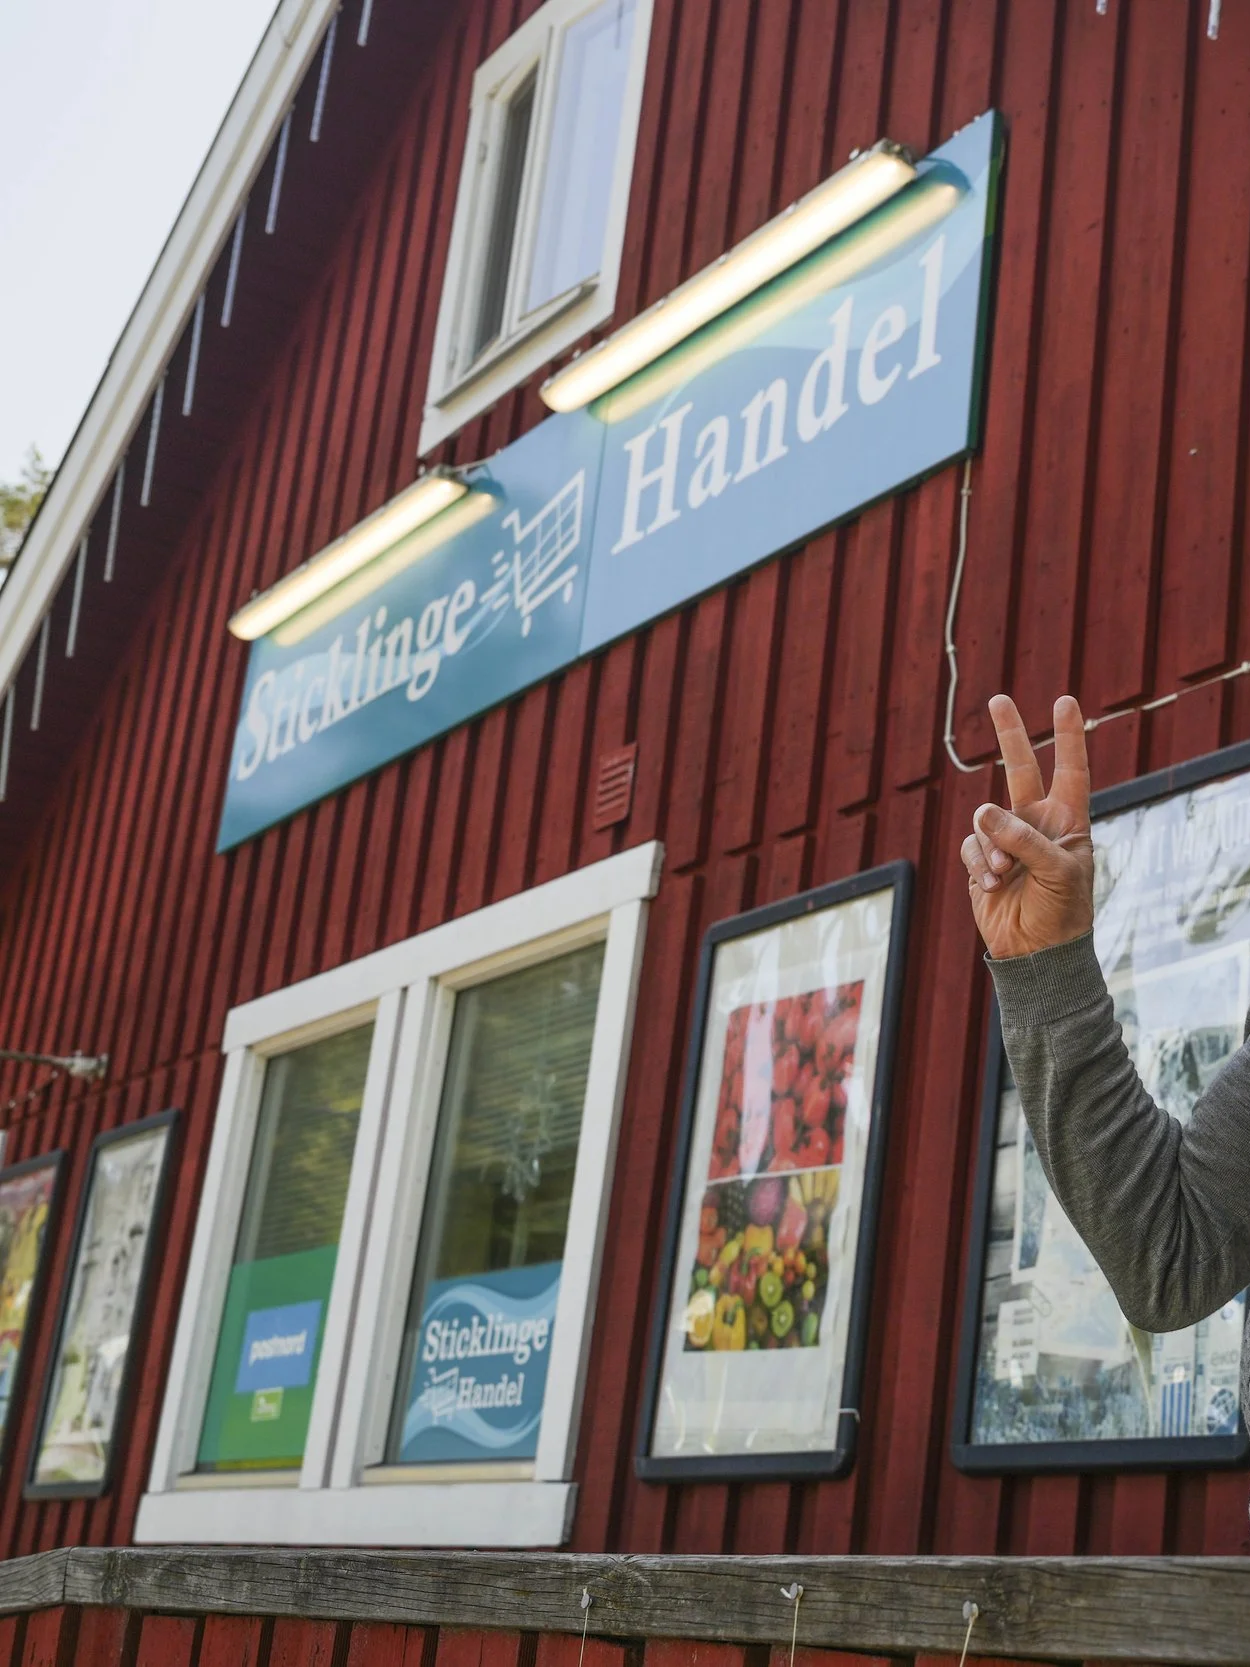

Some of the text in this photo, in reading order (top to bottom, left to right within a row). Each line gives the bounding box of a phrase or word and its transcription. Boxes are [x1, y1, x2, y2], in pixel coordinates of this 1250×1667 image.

[236, 233, 945, 782] Sticklinge Handel
[422, 1312, 549, 1365] Sticklinge
[457, 1372, 526, 1410] Handel
